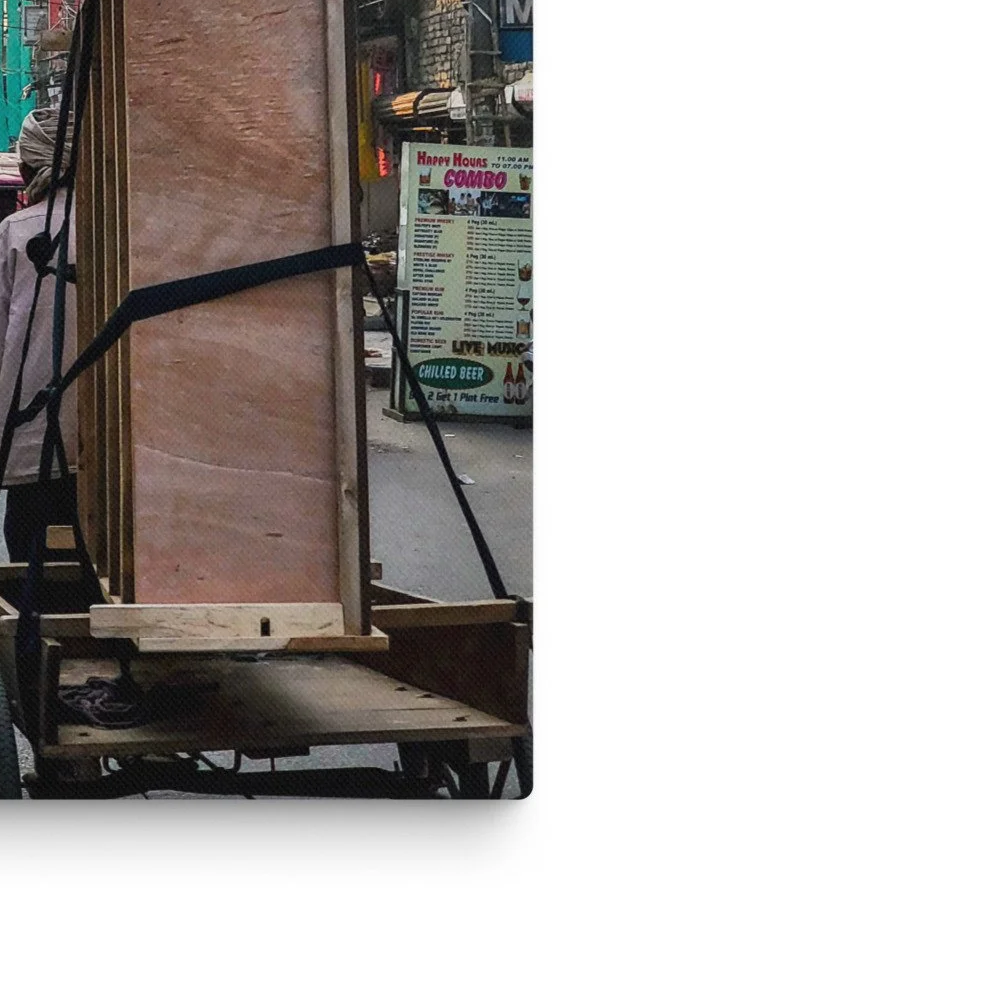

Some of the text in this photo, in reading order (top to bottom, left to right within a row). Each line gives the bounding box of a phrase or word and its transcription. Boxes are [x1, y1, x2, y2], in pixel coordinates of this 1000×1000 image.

[443, 168, 508, 190] COMBO
[452, 340, 485, 356] LIVE
[419, 364, 484, 380] CHILLED BEER
[427, 391, 434, 400] 2
[436, 391, 451, 401] Get
[479, 393, 500, 403] Free
